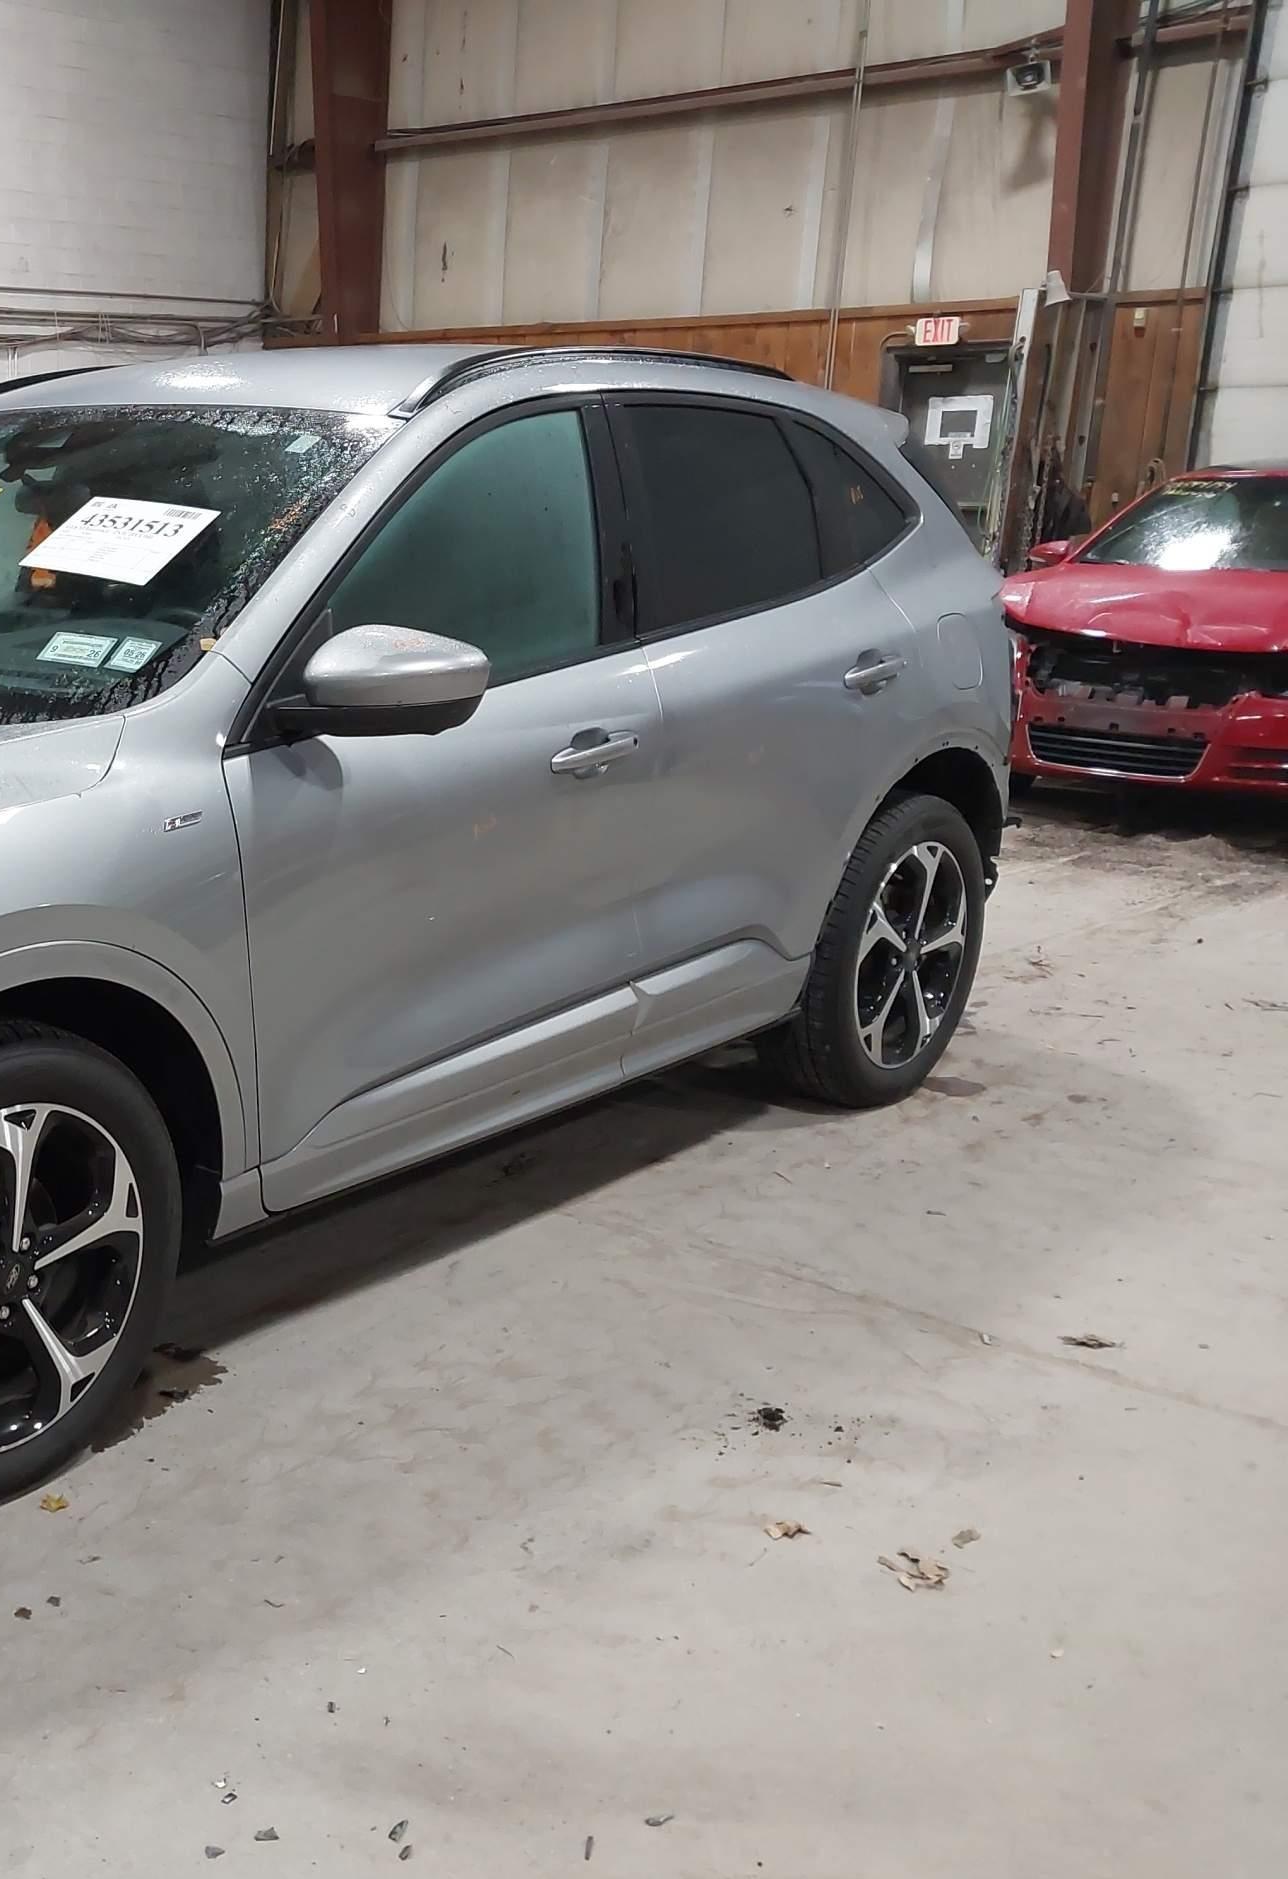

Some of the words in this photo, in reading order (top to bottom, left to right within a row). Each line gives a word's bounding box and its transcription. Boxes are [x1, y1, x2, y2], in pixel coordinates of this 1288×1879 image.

[923, 319, 954, 343] EXIT
[80, 512, 184, 538] 43531513
[87, 649, 102, 658] 26
